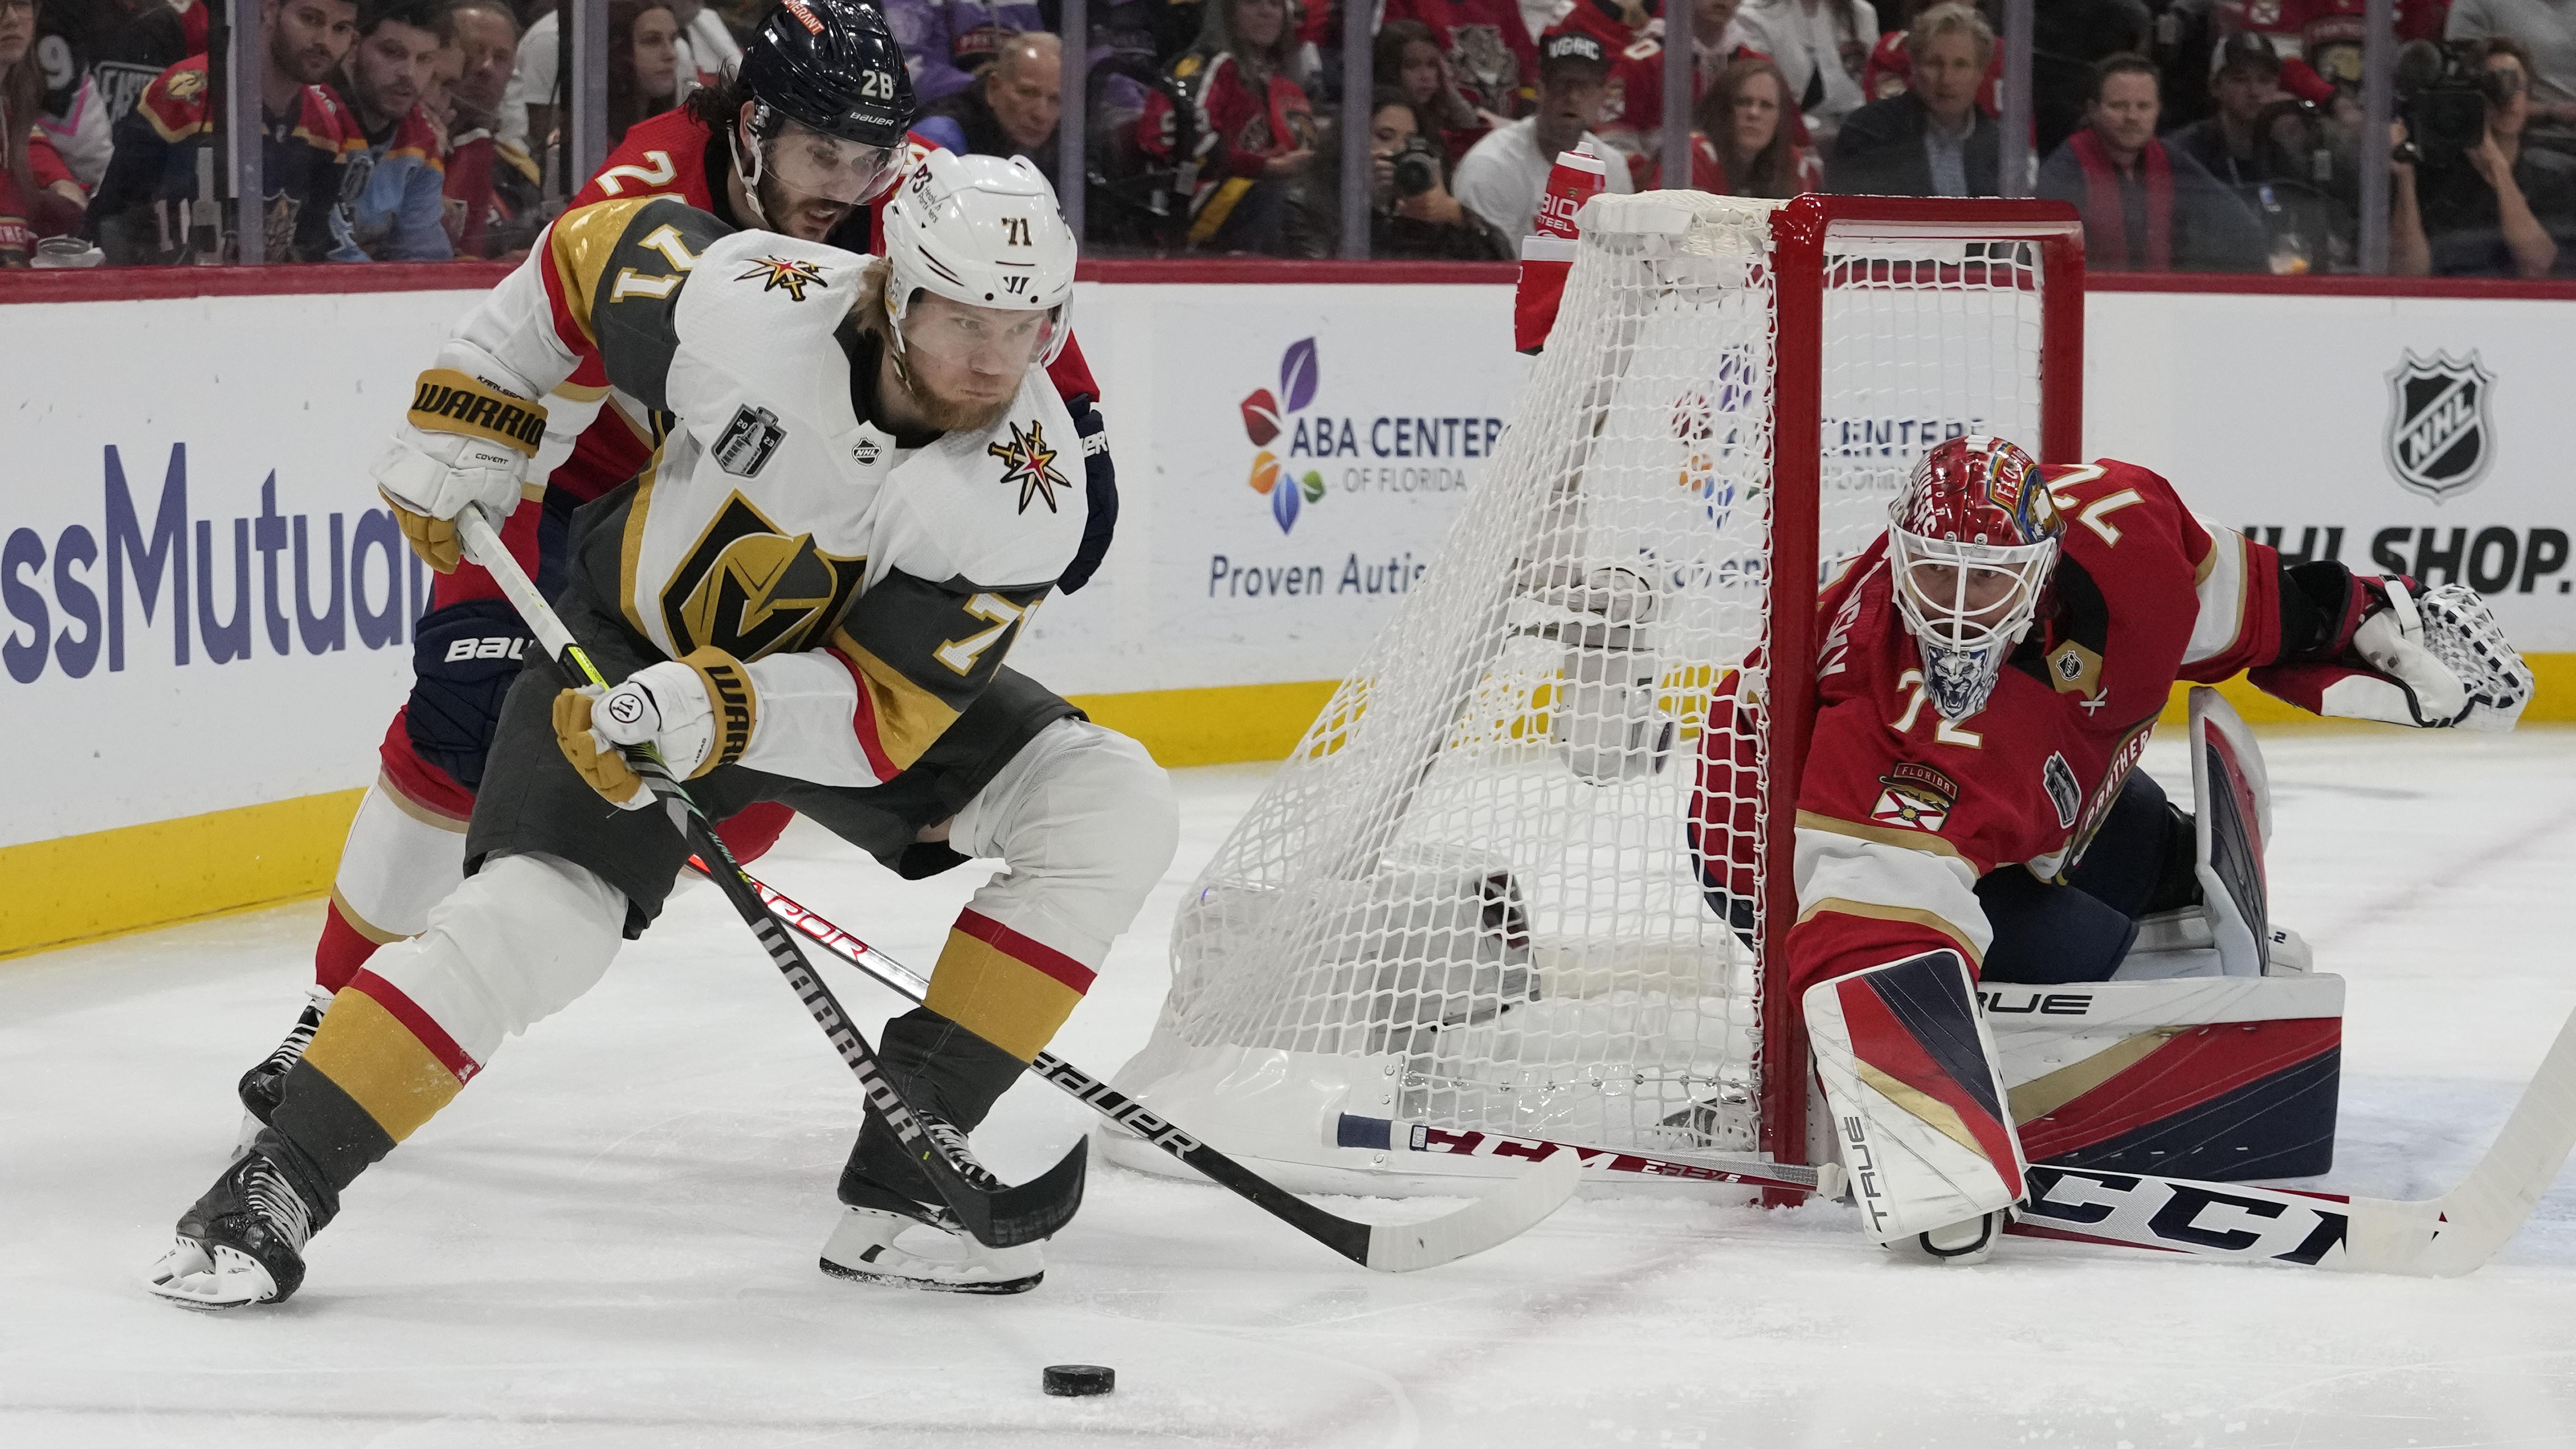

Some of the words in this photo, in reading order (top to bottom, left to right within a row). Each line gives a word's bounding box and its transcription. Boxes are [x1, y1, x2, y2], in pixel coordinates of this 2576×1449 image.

[784, 0, 825, 35] MERANT
[861, 69, 893, 100] 28
[595, 150, 688, 207] 2
[909, 163, 933, 194] P3
[1001, 217, 1032, 246] 71
[412, 383, 547, 451] WARRIO
[737, 418, 748, 430] 20
[2409, 393, 2472, 466] NHL
[763, 436, 775, 447] 23
[1290, 417, 1360, 458] ABA
[1371, 417, 1504, 458] CENTER
[475, 452, 509, 465] COVERT
[1343, 467, 1372, 493] OF
[1379, 467, 1468, 493] FLORIDA
[1209, 554, 1325, 597] Proven
[2371, 526, 2570, 594] SHOP.
[2066, 658, 2075, 677] NHL
[1902, 766, 1951, 793] FLORIDA
[2084, 721, 2158, 832] PANTHER
[750, 916, 922, 1144] WARRIOR
[1838, 1116, 1888, 1234] TRUE
